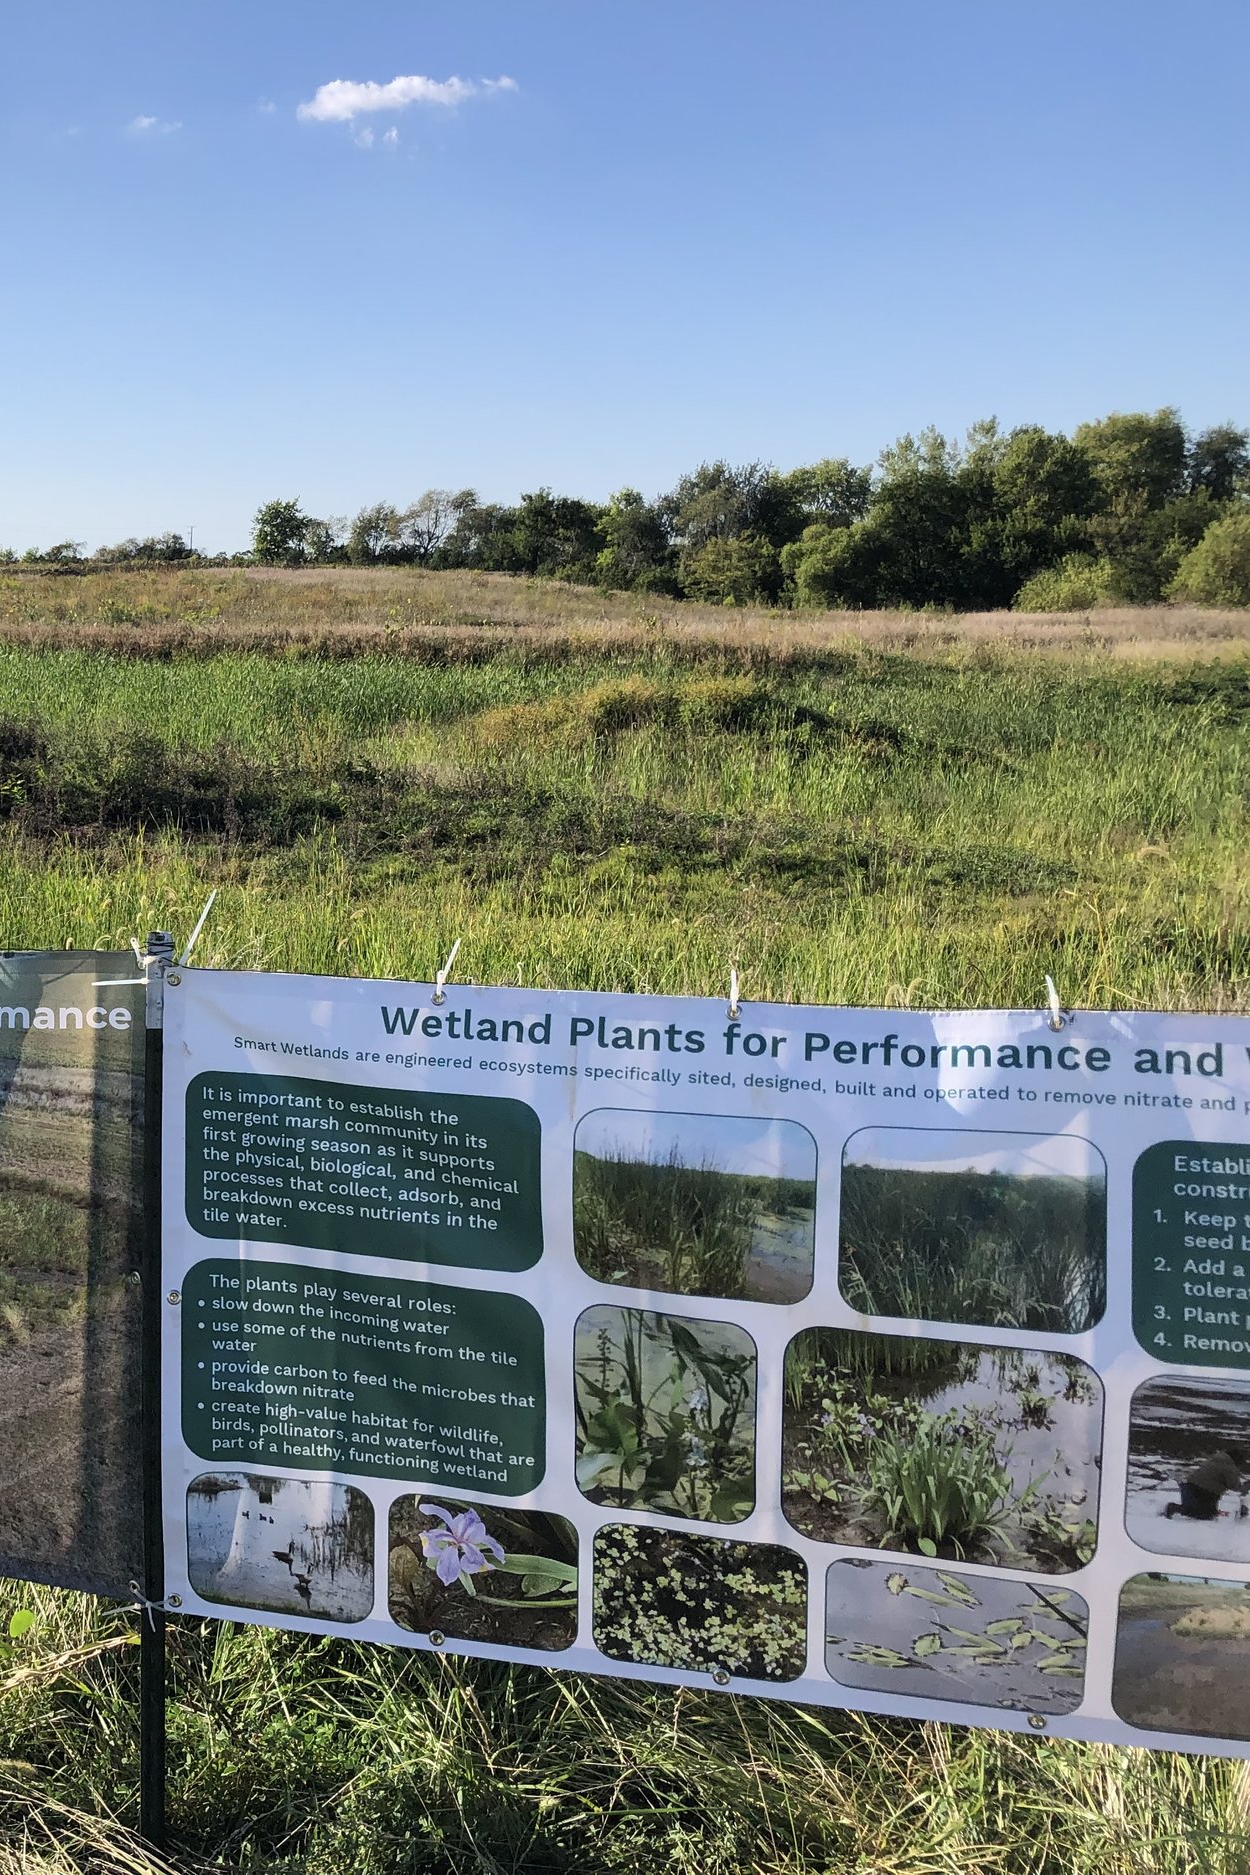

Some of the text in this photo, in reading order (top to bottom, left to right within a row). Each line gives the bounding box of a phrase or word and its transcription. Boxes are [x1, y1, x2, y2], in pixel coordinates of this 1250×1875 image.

[381, 1006, 551, 1044] Wetland
[570, 1016, 705, 1053] Plants
[723, 1023, 786, 1057] for
[805, 1033, 1110, 1071] Performance
[1134, 1043, 1223, 1077] and
[234, 1037, 277, 1054] Smart
[281, 1042, 348, 1060] Wetlands
[356, 1052, 380, 1062] are
[386, 1052, 472, 1069] engineered
[480, 1061, 577, 1076] ecosystems
[585, 1066, 681, 1086] specifically
[689, 1071, 735, 1088] sited,
[744, 1074, 826, 1094] designed,
[836, 1080, 876, 1096] built
[883, 1084, 915, 1098] and
[924, 1086, 1009, 1102] operated
[1017, 1088, 1037, 1101] to
[1045, 1092, 1116, 1105] remove
[1125, 1091, 1192, 1108] nitrate
[1201, 1096, 1235, 1111] and
[204, 1087, 458, 1125] It is important to establish the
[203, 1110, 487, 1148] emergent marsh community in its
[204, 1171, 500, 1210] processes that collect, adsorb, and
[204, 1187, 497, 1229] breakdown excess nutrients in the
[203, 1208, 286, 1227] tile water.
[1154, 1209, 1236, 1231] 1. Keep
[1185, 1235, 1233, 1249] seed
[1154, 1257, 1245, 1276] 2. Add a
[209, 1274, 456, 1314] The plants play several roles:
[213, 1297, 449, 1334] slow down the incoming water
[1154, 1305, 1240, 1325] 3. Plant
[1154, 1332, 1172, 1346] 4.
[212, 1403, 503, 1449] create high-value habitat for wildlife,
[213, 1437, 507, 1482] part of a healthy, functioning wetland
